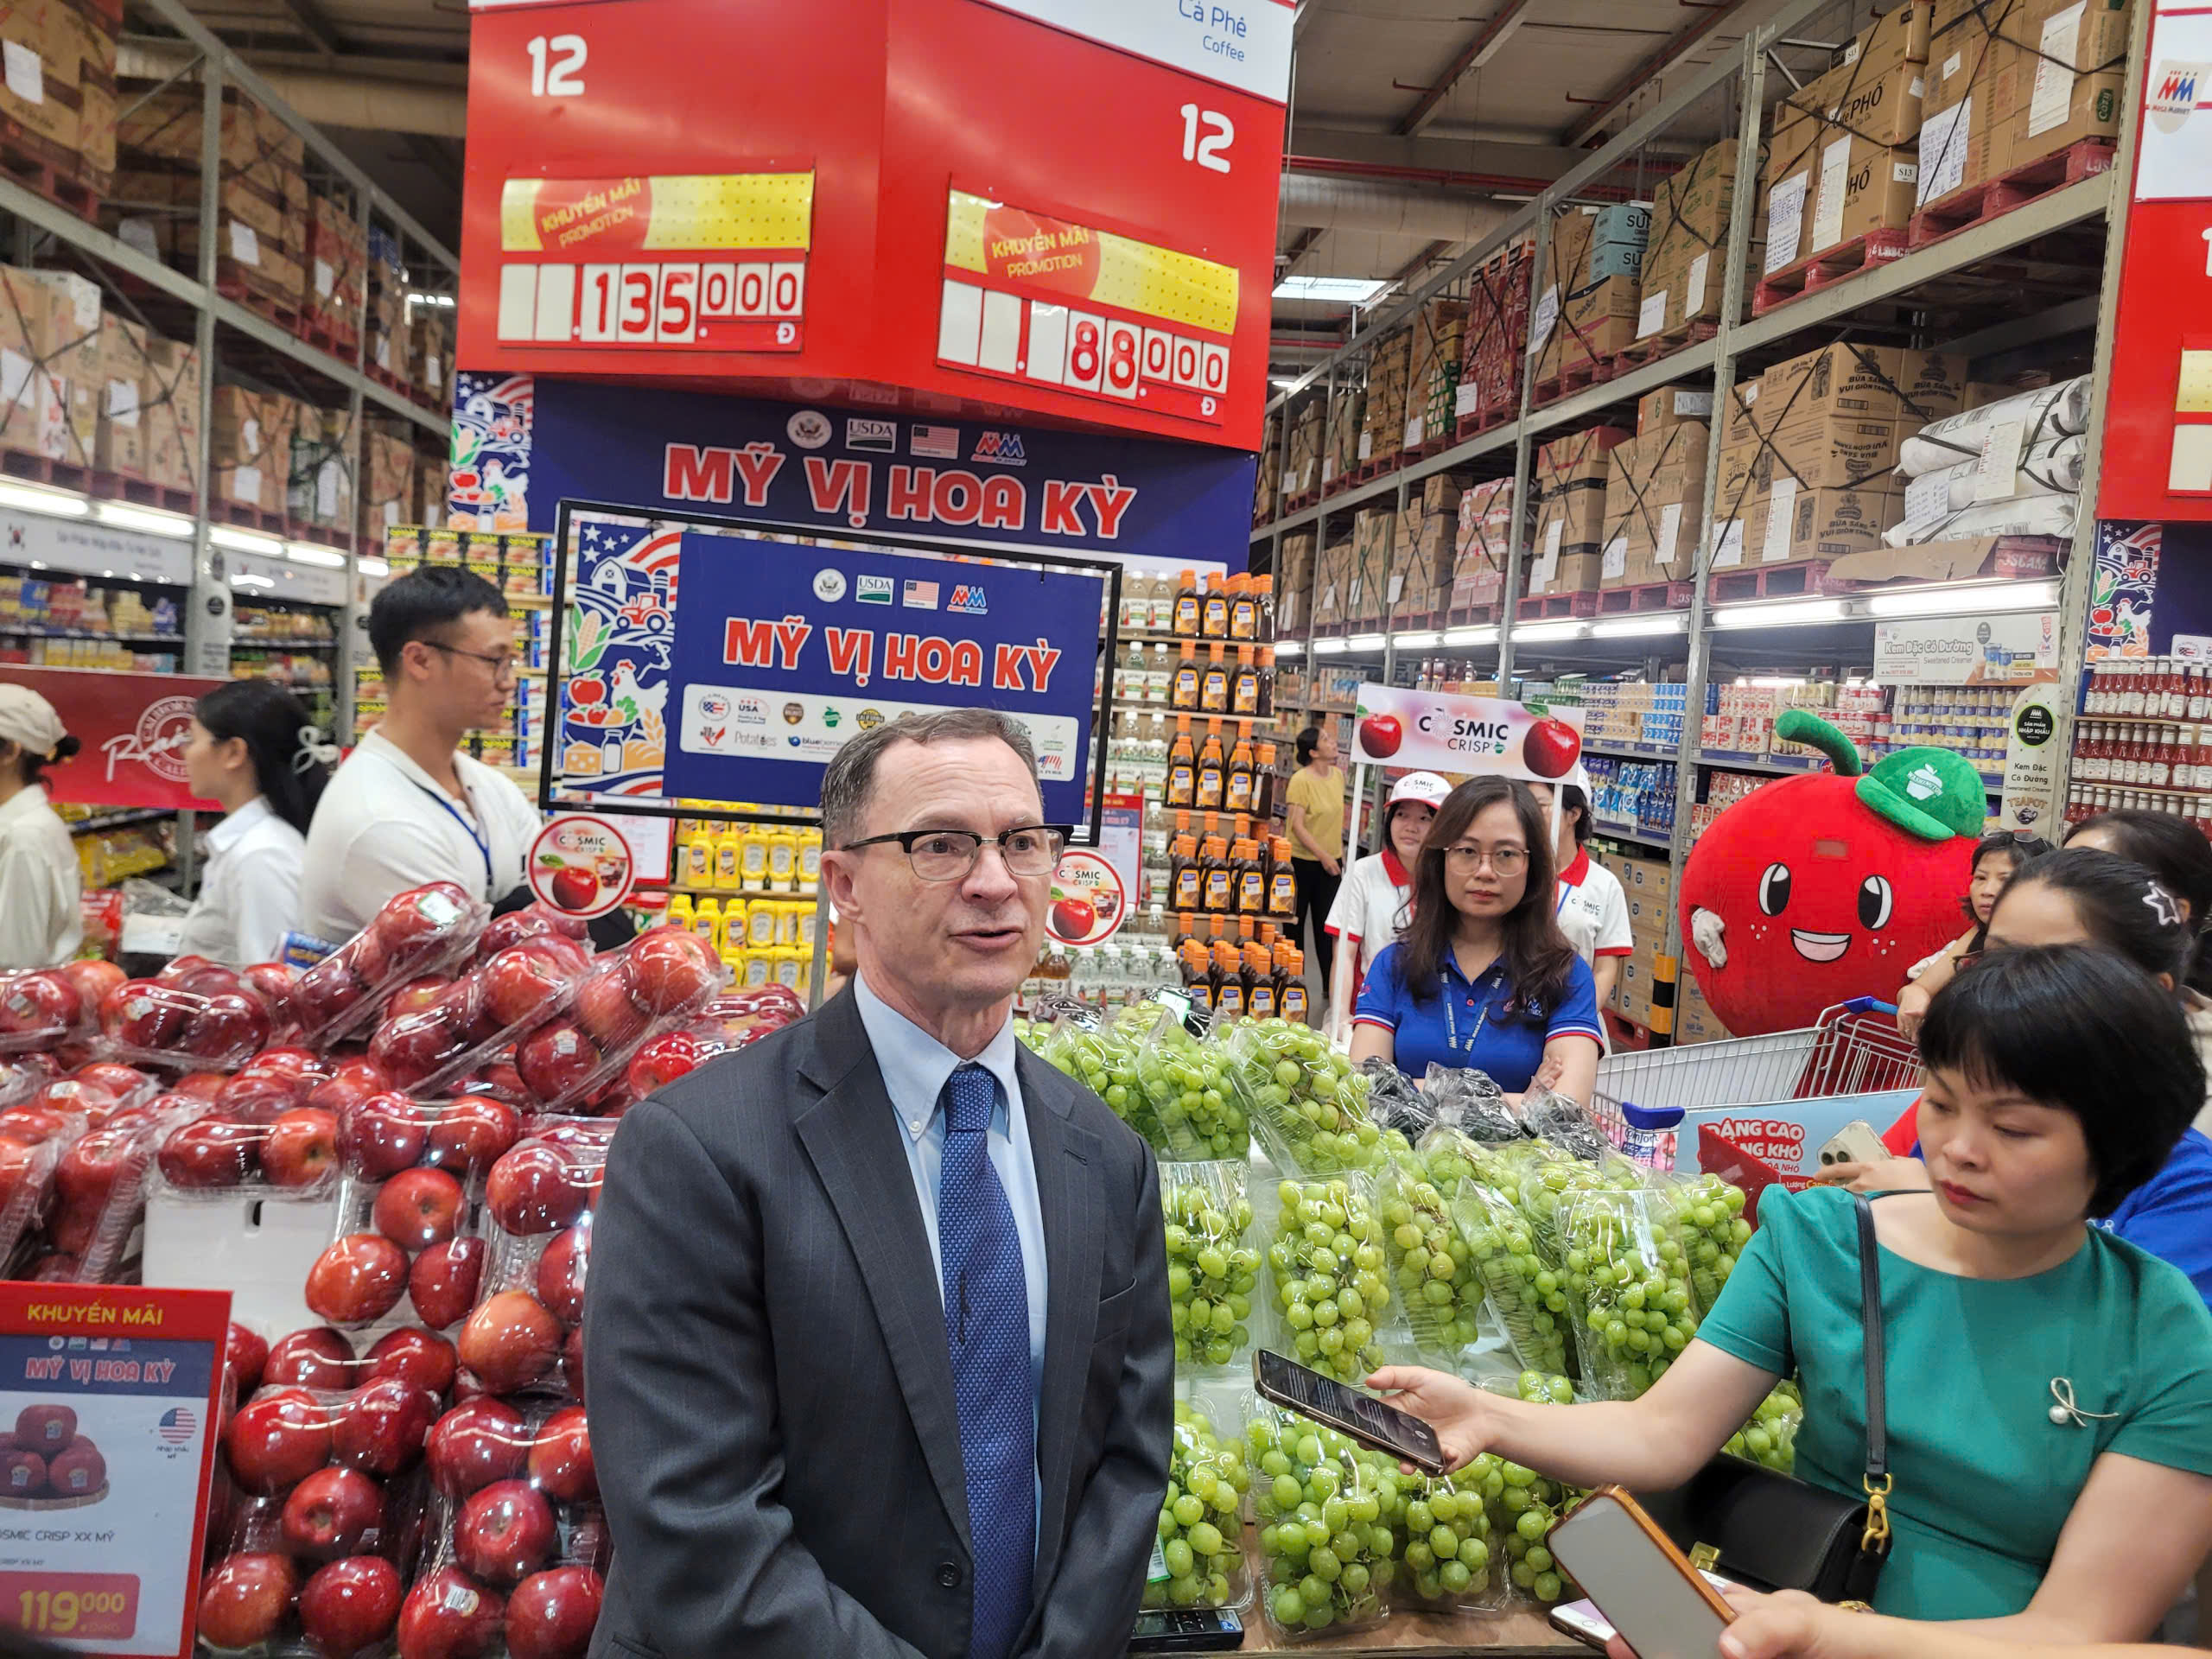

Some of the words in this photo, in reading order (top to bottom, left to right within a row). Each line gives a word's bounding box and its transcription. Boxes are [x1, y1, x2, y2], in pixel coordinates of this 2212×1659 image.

[1211, 7, 1248, 38] Phê
[1203, 35, 1246, 63] Coffee
[527, 34, 588, 98] 12
[2098, 90, 2113, 121] Cozy
[1180, 103, 1236, 174] 12
[1847, 160, 1873, 197] HỐ
[1897, 168, 1913, 177] S13
[541, 188, 607, 234] KHUYẾN
[608, 177, 642, 207] MÃI
[559, 207, 634, 248] PROMOTION
[992, 228, 1057, 259] KHUYẾN
[1059, 225, 1090, 249] MÃI
[1007, 253, 1084, 279] PROMOTION
[849, 421, 893, 437] USDA
[663, 442, 785, 507] MỸ
[803, 455, 873, 528] VỊ
[886, 463, 1027, 530] HOA
[1040, 474, 1137, 539] KỲ
[858, 575, 892, 592] USDA
[722, 615, 812, 670] MỸ
[824, 626, 874, 688] VỊ
[883, 633, 983, 688] HOA
[993, 638, 1061, 693] KỲ
[1885, 642, 1904, 654] Kem
[739, 704, 759, 713] USA
[1447, 738, 1491, 753] CRISP
[2014, 762, 2030, 771] Kem
[2032, 763, 2047, 772] Đặc
[2006, 796, 2048, 810] TEAPOT
[1766, 1122, 1803, 1141] CAO
[28, 1299, 116, 1325] KHUYẾN
[123, 1303, 163, 1325] MÃI
[26, 1355, 67, 1381] MỸ
[70, 1359, 92, 1384] VỊ
[95, 1360, 140, 1382] HOA
[143, 1358, 176, 1383] KỲ
[35, 1529, 71, 1541] CRISP
[74, 1531, 92, 1542] XX
